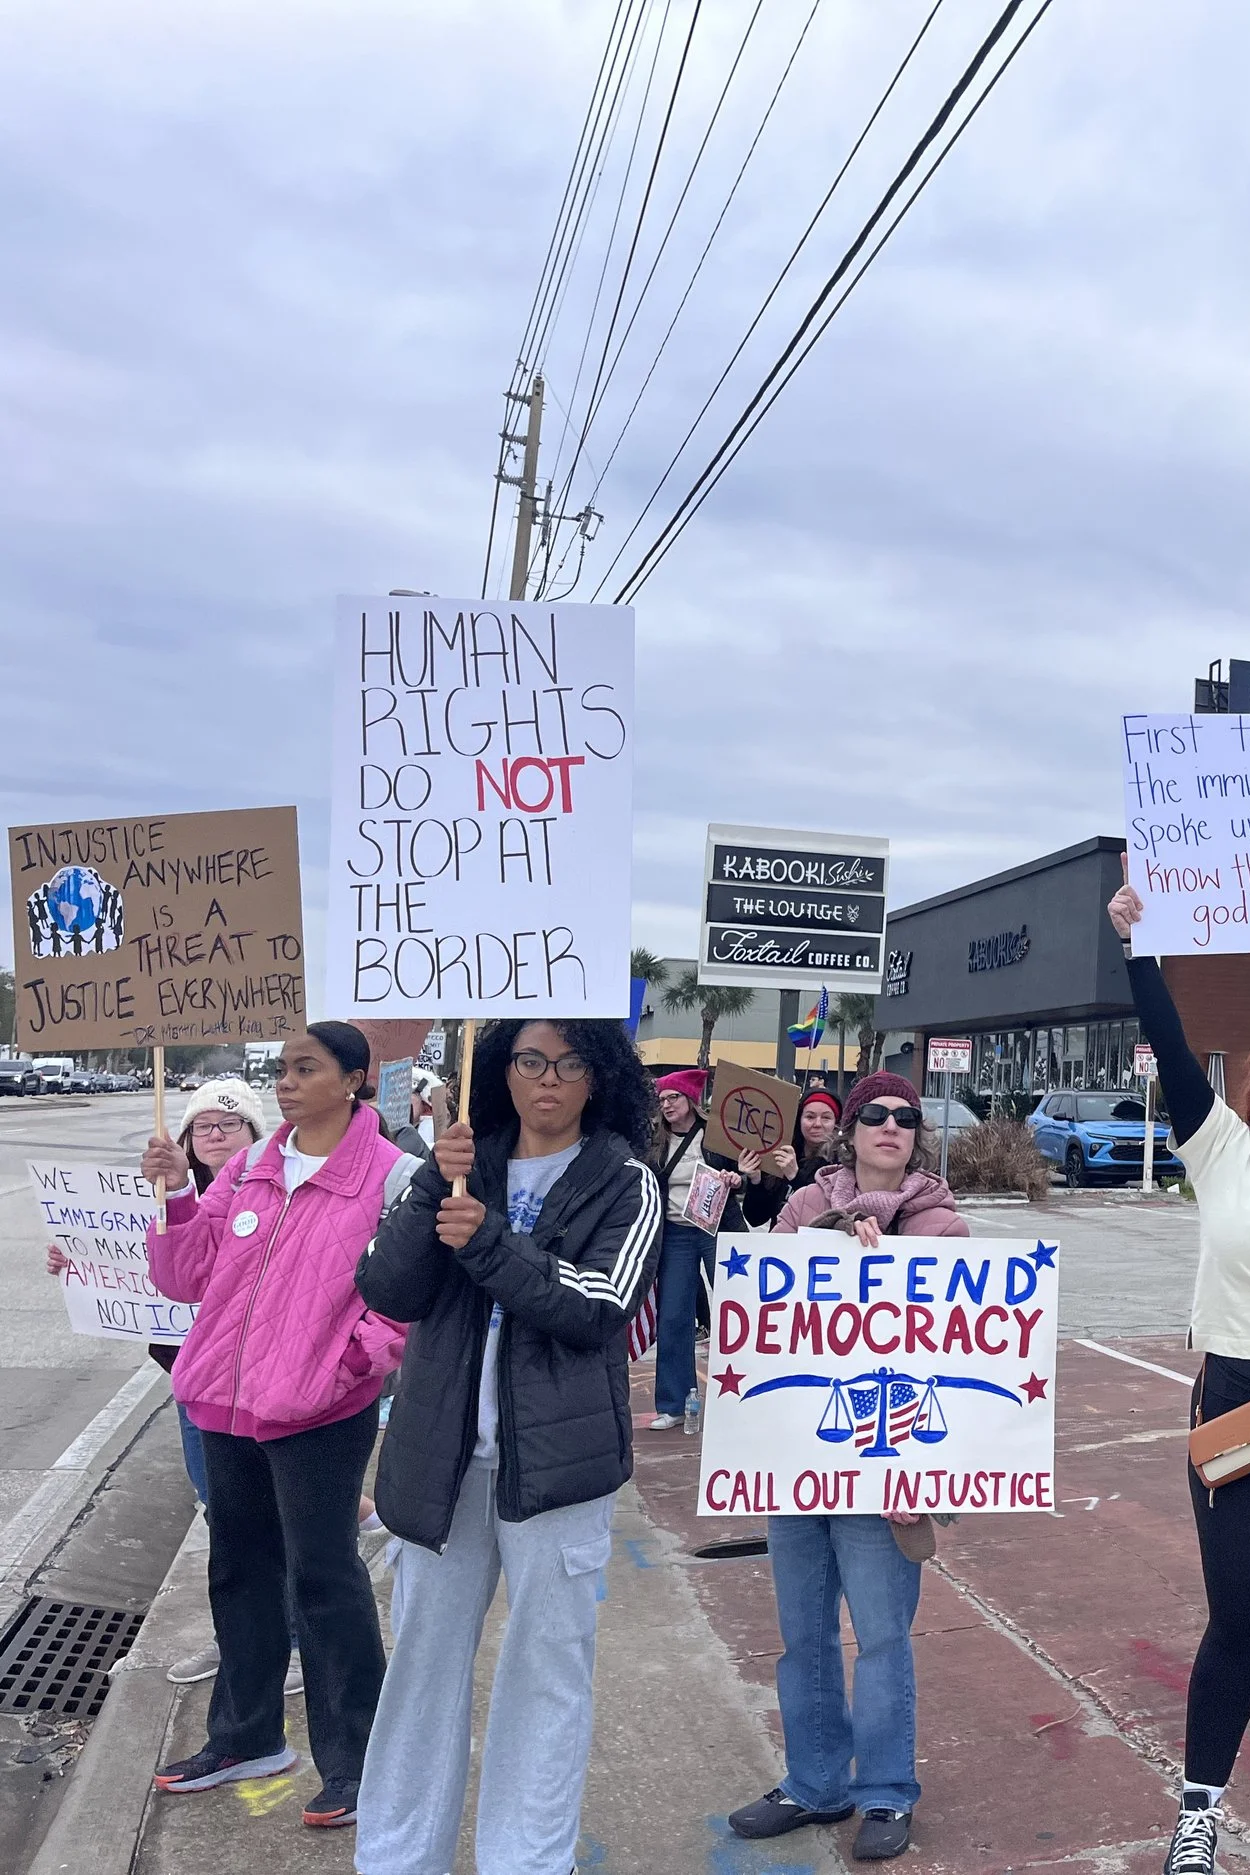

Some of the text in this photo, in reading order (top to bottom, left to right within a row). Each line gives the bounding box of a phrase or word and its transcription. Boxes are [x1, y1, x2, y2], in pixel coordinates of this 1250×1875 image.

[361, 611, 559, 687] HUMAN
[361, 684, 626, 760] RIGHTS
[1122, 715, 1204, 764] First
[360, 756, 585, 814] DO NOT
[1128, 762, 1182, 808] the
[15, 821, 166, 872] INJUSTICE
[347, 817, 558, 885] STOP AT
[122, 847, 273, 895] ANYWHERE
[723, 855, 864, 886] KABOOKI Sushi
[152, 898, 228, 930] IS A
[350, 881, 433, 933] THE
[733, 897, 843, 921] THE LOUNGE
[1192, 890, 1249, 947] god
[128, 931, 302, 977] THREAT TO
[354, 926, 587, 1002] BORDER
[713, 930, 875, 969] Foxtail COFFEE CO.
[23, 973, 304, 1033] JUSTICE EVERYWHERE
[933, 1057, 945, 1068] NO
[1139, 1062, 1149, 1073] NO
[217, 1095, 239, 1110] UCF
[728, 1097, 778, 1145] ICE
[32, 1165, 157, 1198] WE NEE
[700, 1179, 721, 1219] WELCOME
[41, 1201, 152, 1232] IMMIGRAN
[55, 1234, 88, 1256] TO
[66, 1258, 162, 1297] AMERIC
[758, 1255, 1037, 1305] DEFEND
[97, 1298, 141, 1330] NOT
[719, 1300, 1044, 1358] DEMOCRACY
[706, 1468, 1053, 1513] CALL OUT INJUSTICE
